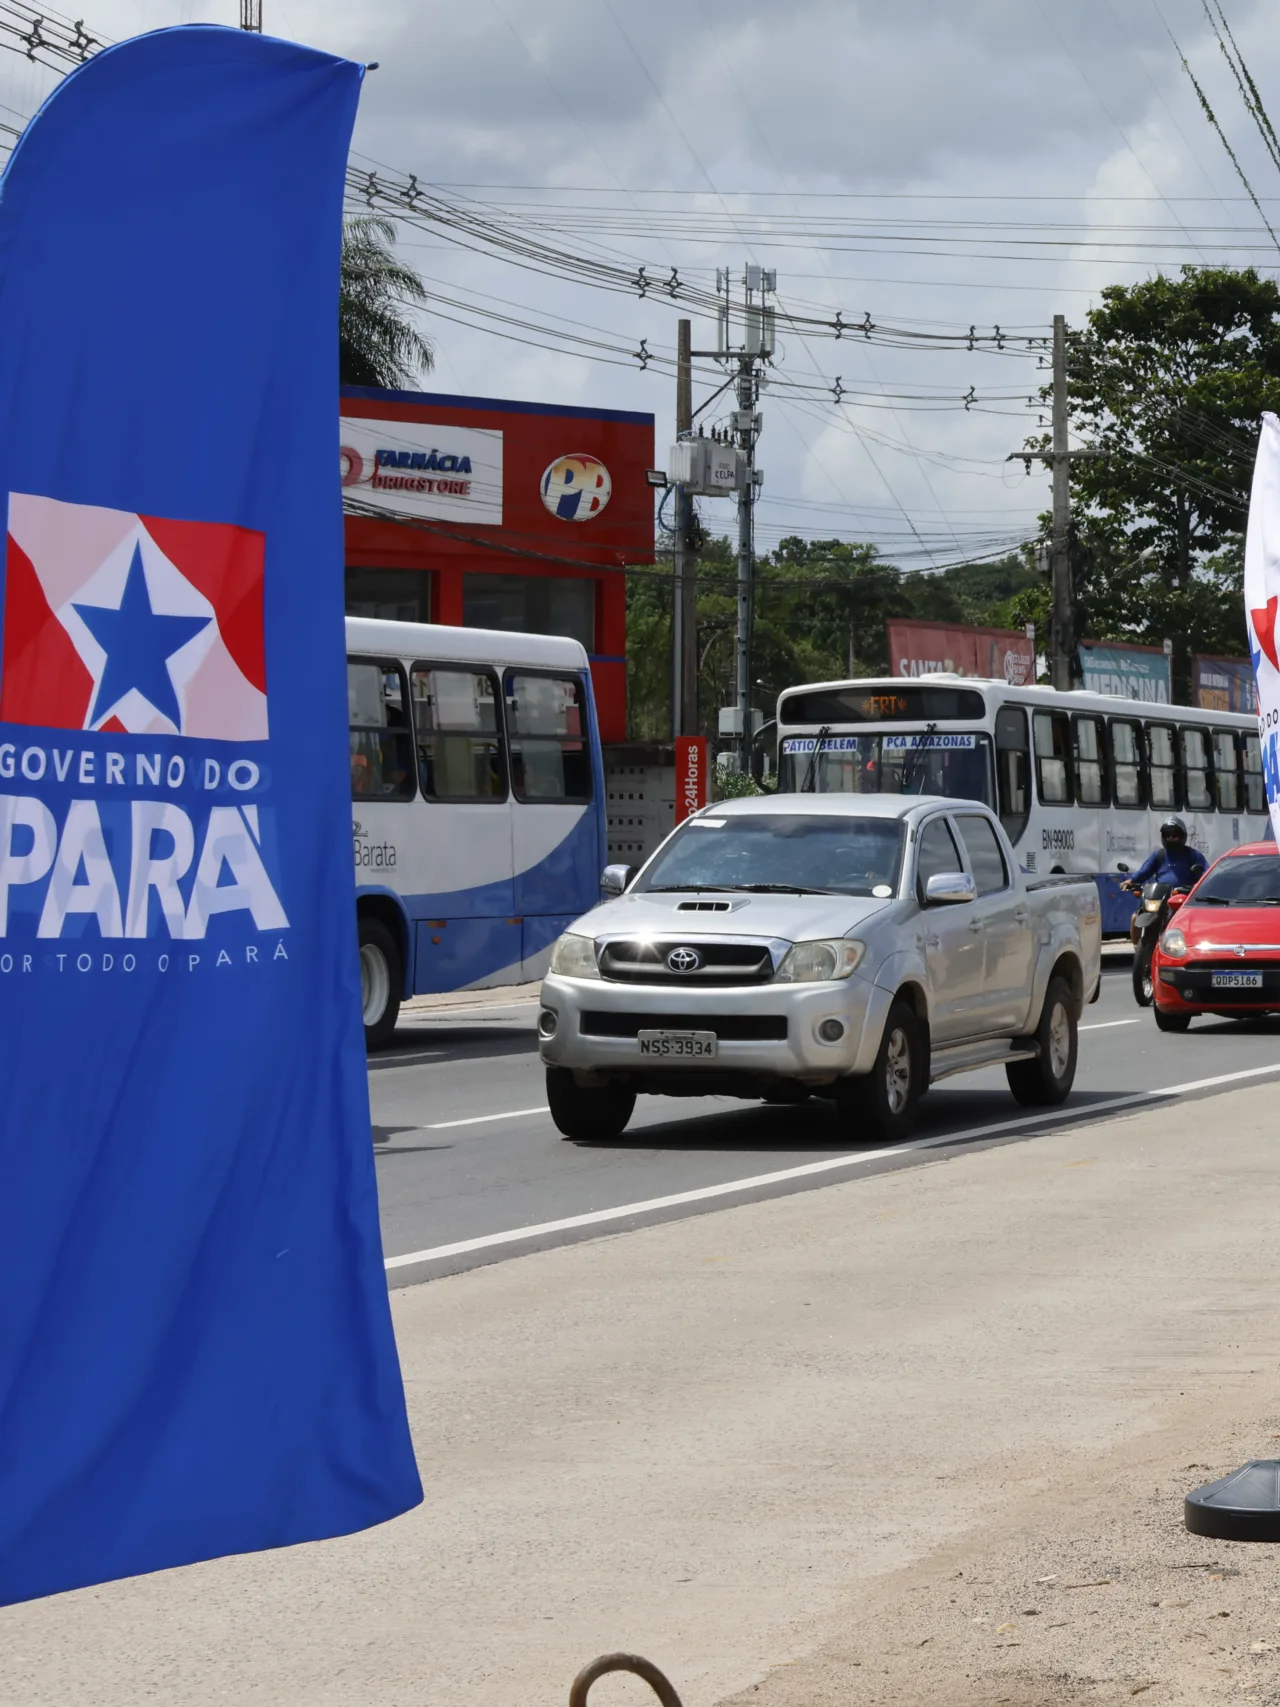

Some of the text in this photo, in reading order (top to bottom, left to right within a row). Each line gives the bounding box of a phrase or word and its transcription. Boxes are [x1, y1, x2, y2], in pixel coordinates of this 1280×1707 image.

[375, 449, 472, 474] FARMÁCIA
[371, 474, 472, 495] DRUGSTORE
[821, 737, 857, 750] BELÉM
[910, 735, 972, 749] AMAZONAS
[0, 743, 260, 791] GOVERNO DO
[353, 840, 396, 867] Barata
[56, 954, 136, 973] TODO
[158, 954, 169, 973] O
[188, 938, 289, 973] PARÁ
